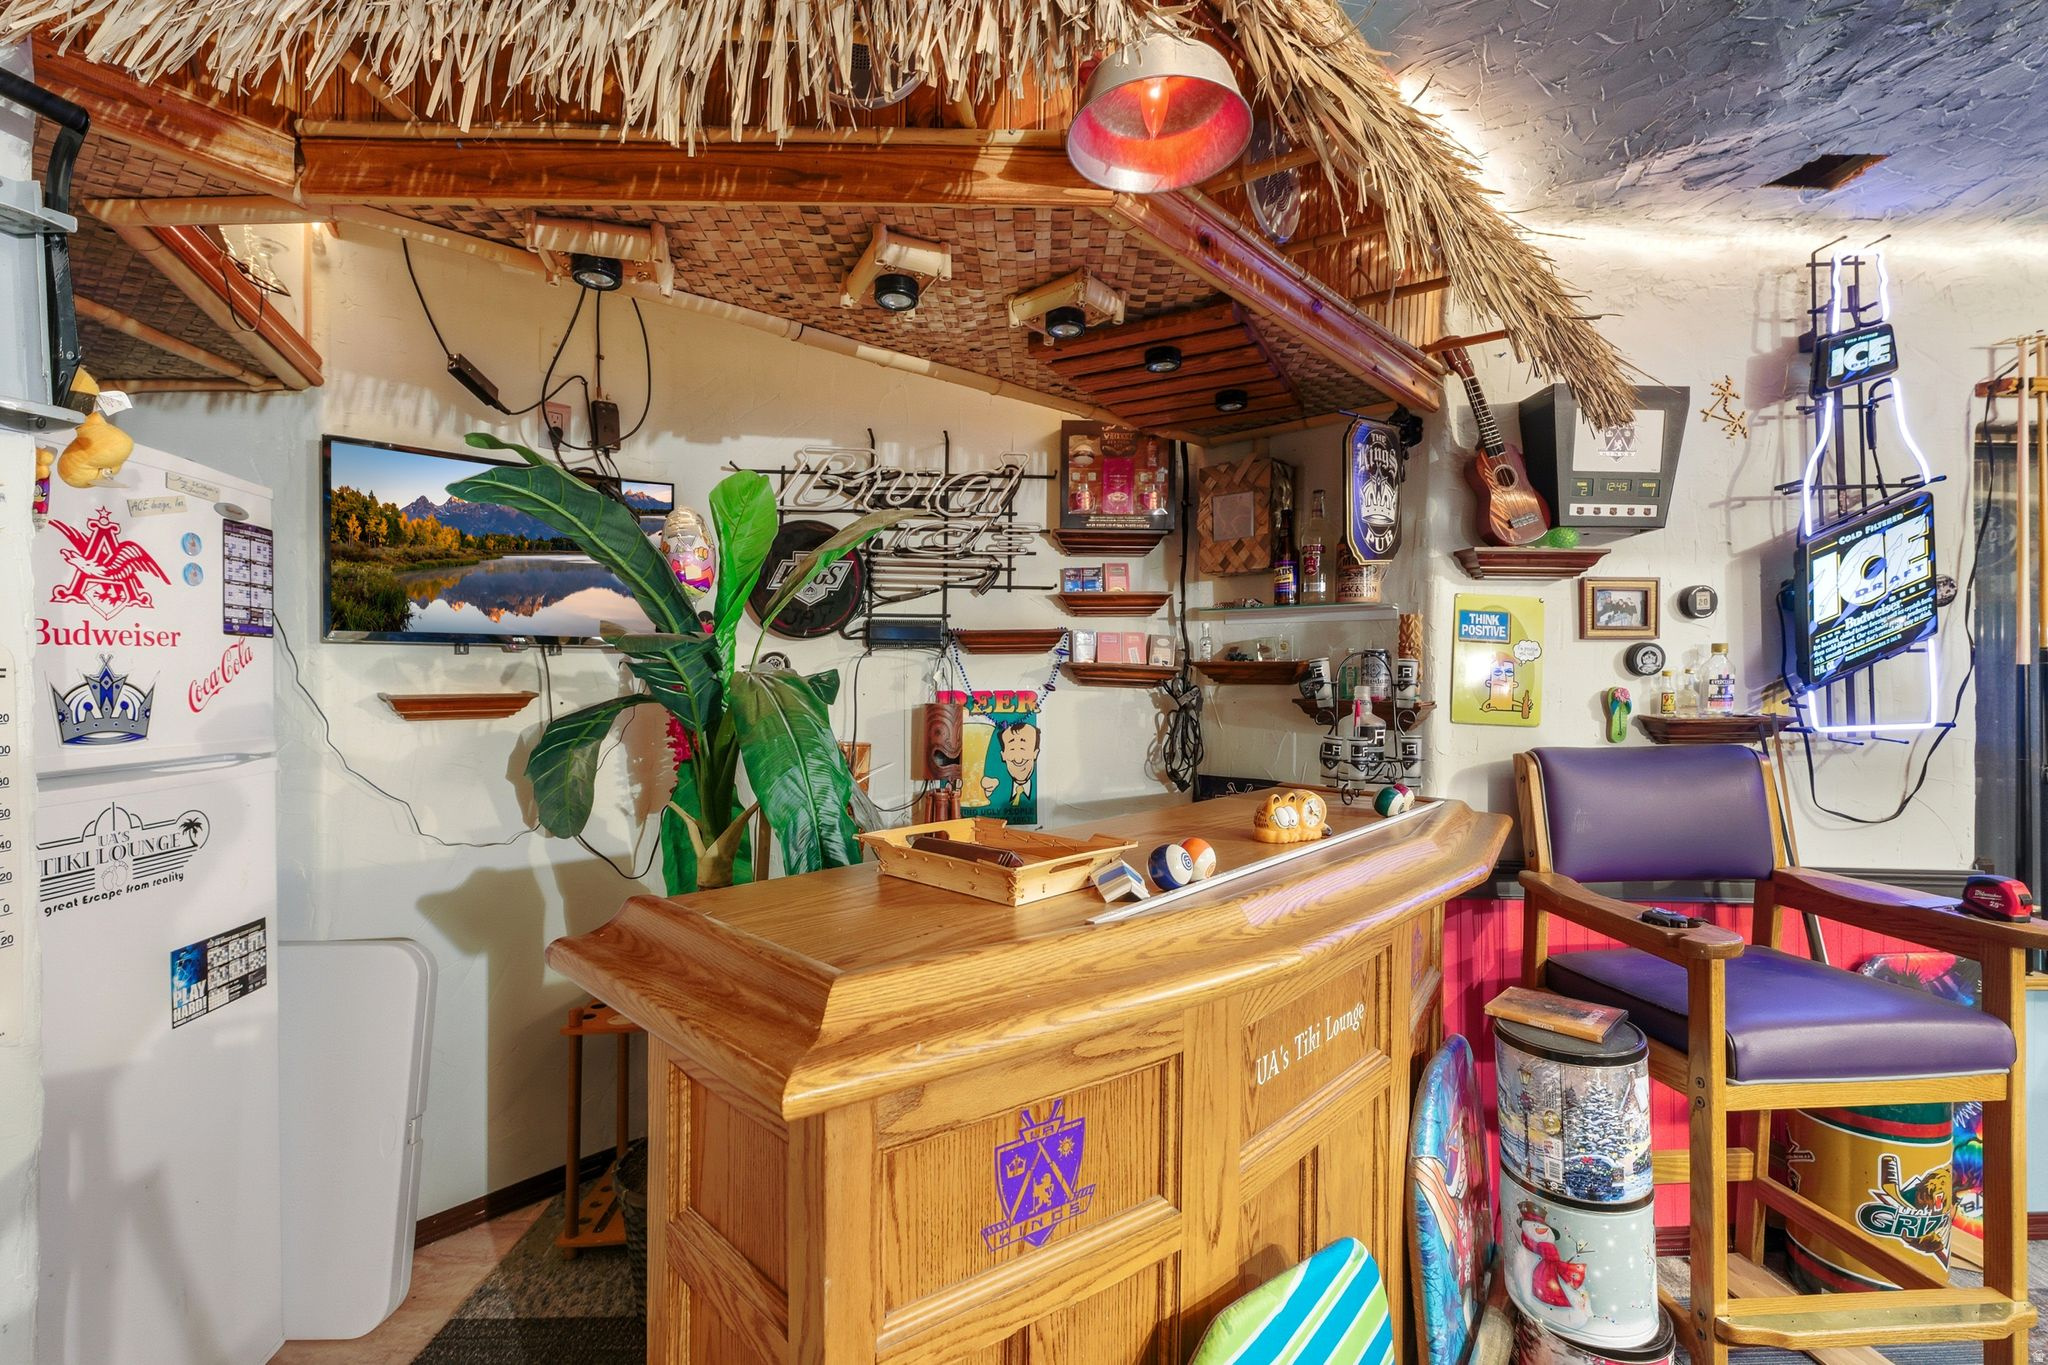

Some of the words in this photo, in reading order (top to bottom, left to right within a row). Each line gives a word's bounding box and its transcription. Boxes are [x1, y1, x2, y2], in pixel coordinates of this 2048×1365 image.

[1831, 335, 1891, 377] ICE
[1370, 433, 1386, 443] THE
[777, 446, 1030, 517] Bud
[1365, 528, 1394, 551] PUB
[1838, 530, 1862, 545] COLD
[1865, 513, 1904, 534] FILTERED
[1813, 514, 1931, 623] ICE
[1855, 564, 1923, 598] DRAFT
[36, 618, 181, 648] Budweiser
[1462, 625, 1506, 637] POSITIVE
[1469, 614, 1500, 626] THINK
[188, 635, 254, 714] Coca-Cola
[38, 849, 91, 876] TIKI
[95, 832, 181, 866] LOUNGE
[0, 872, 12, 882] 20
[3, 903, 10, 913] 0
[44, 898, 78, 917] great
[82, 887, 122, 905] Escape
[126, 881, 150, 894] from
[152, 871, 184, 889] reality
[1, 934, 14, 946] 20
[173, 979, 207, 1008] PLAY
[1256, 1045, 1289, 1085] UA's
[1295, 1023, 1320, 1061] Tiki
[1325, 1002, 1364, 1042] Lounge
[1000, 1201, 1081, 1245] KINGS
